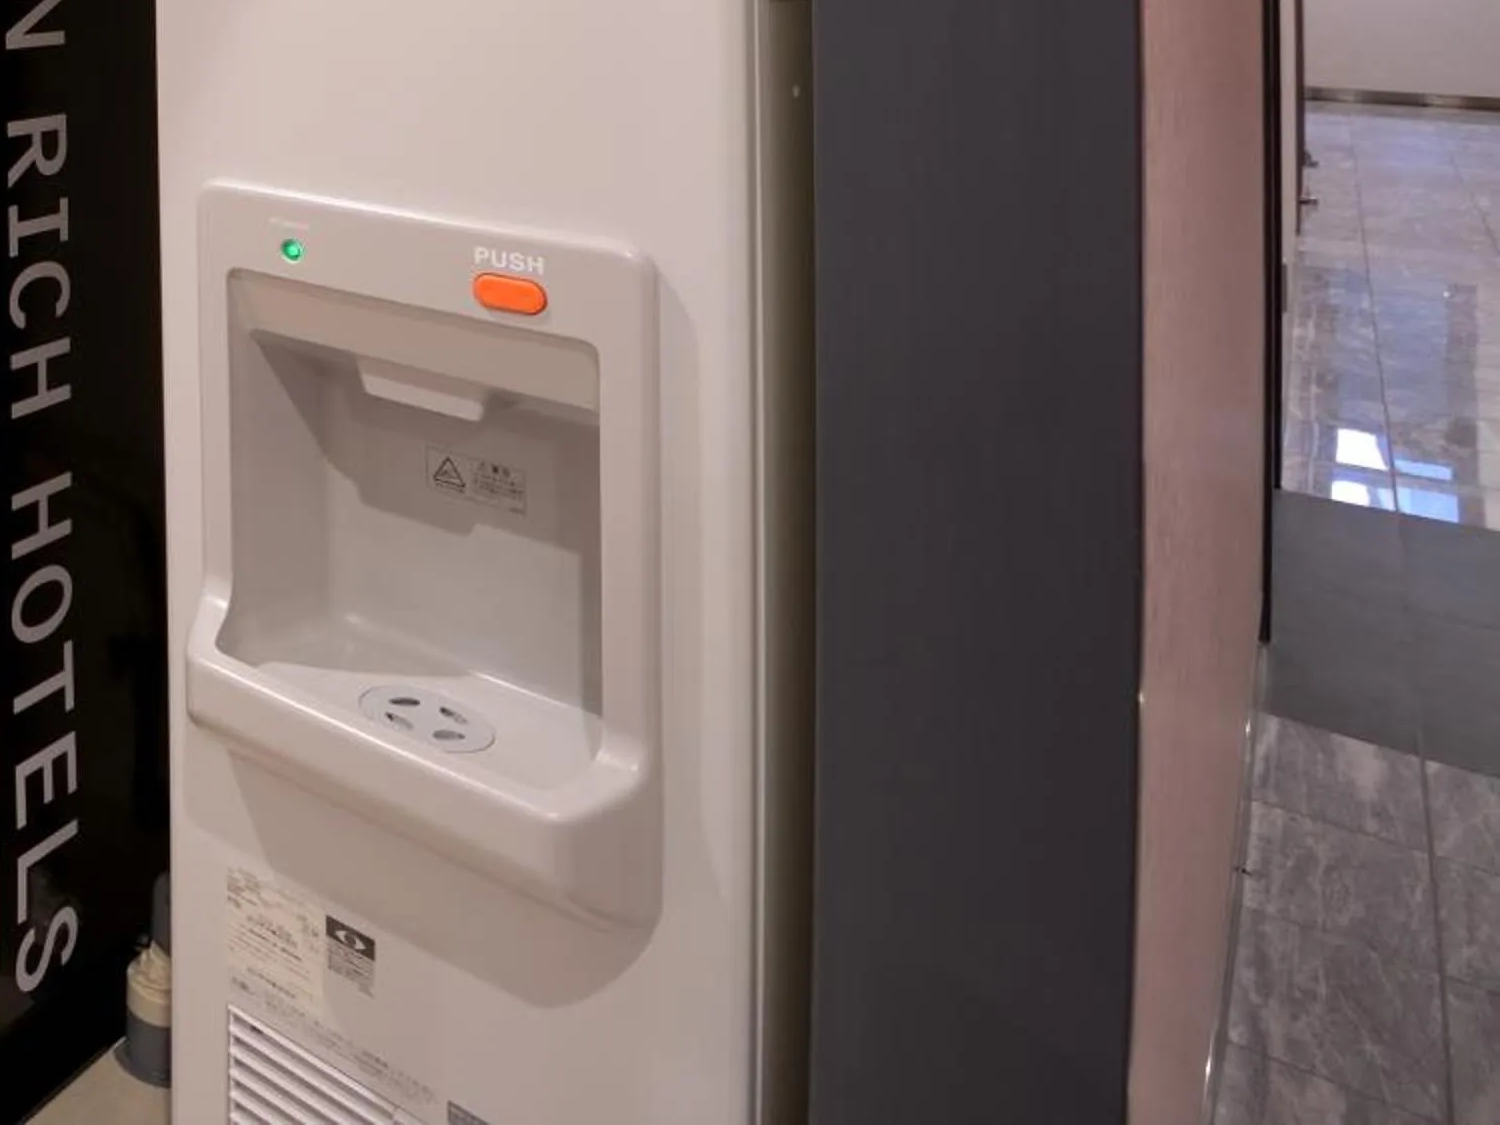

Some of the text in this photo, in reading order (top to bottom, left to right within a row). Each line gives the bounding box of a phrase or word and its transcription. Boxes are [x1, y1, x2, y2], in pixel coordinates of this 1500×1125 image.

[5, 113, 73, 421] RICH
[474, 246, 546, 275] PUSH
[9, 471, 79, 995] HOTELS
